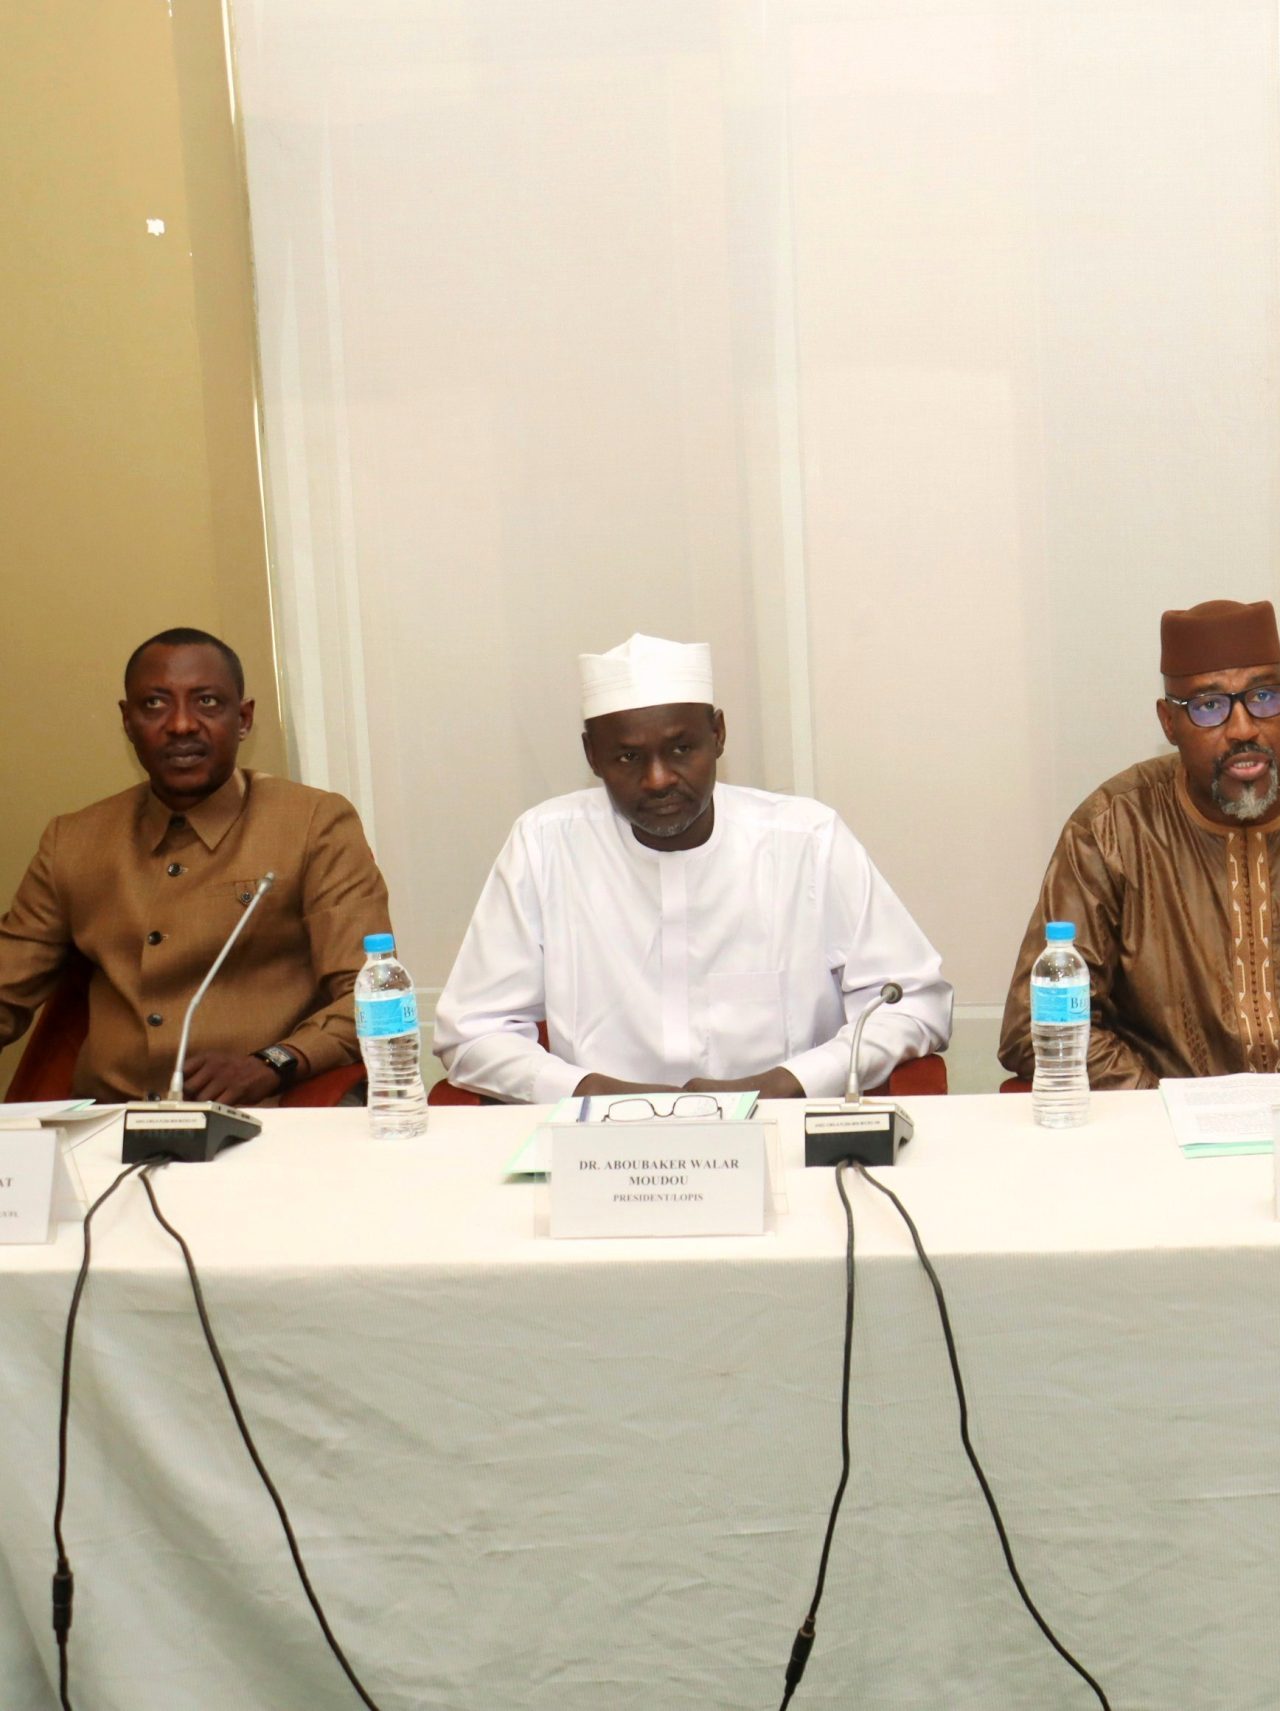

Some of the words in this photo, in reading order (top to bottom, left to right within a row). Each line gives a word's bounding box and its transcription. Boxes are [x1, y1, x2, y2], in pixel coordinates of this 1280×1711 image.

[579, 1160, 600, 1170] DR.
[604, 1159, 687, 1170] ABOUBAKER
[691, 1158, 739, 1169] WALAR
[629, 1175, 689, 1186] MOUDOU
